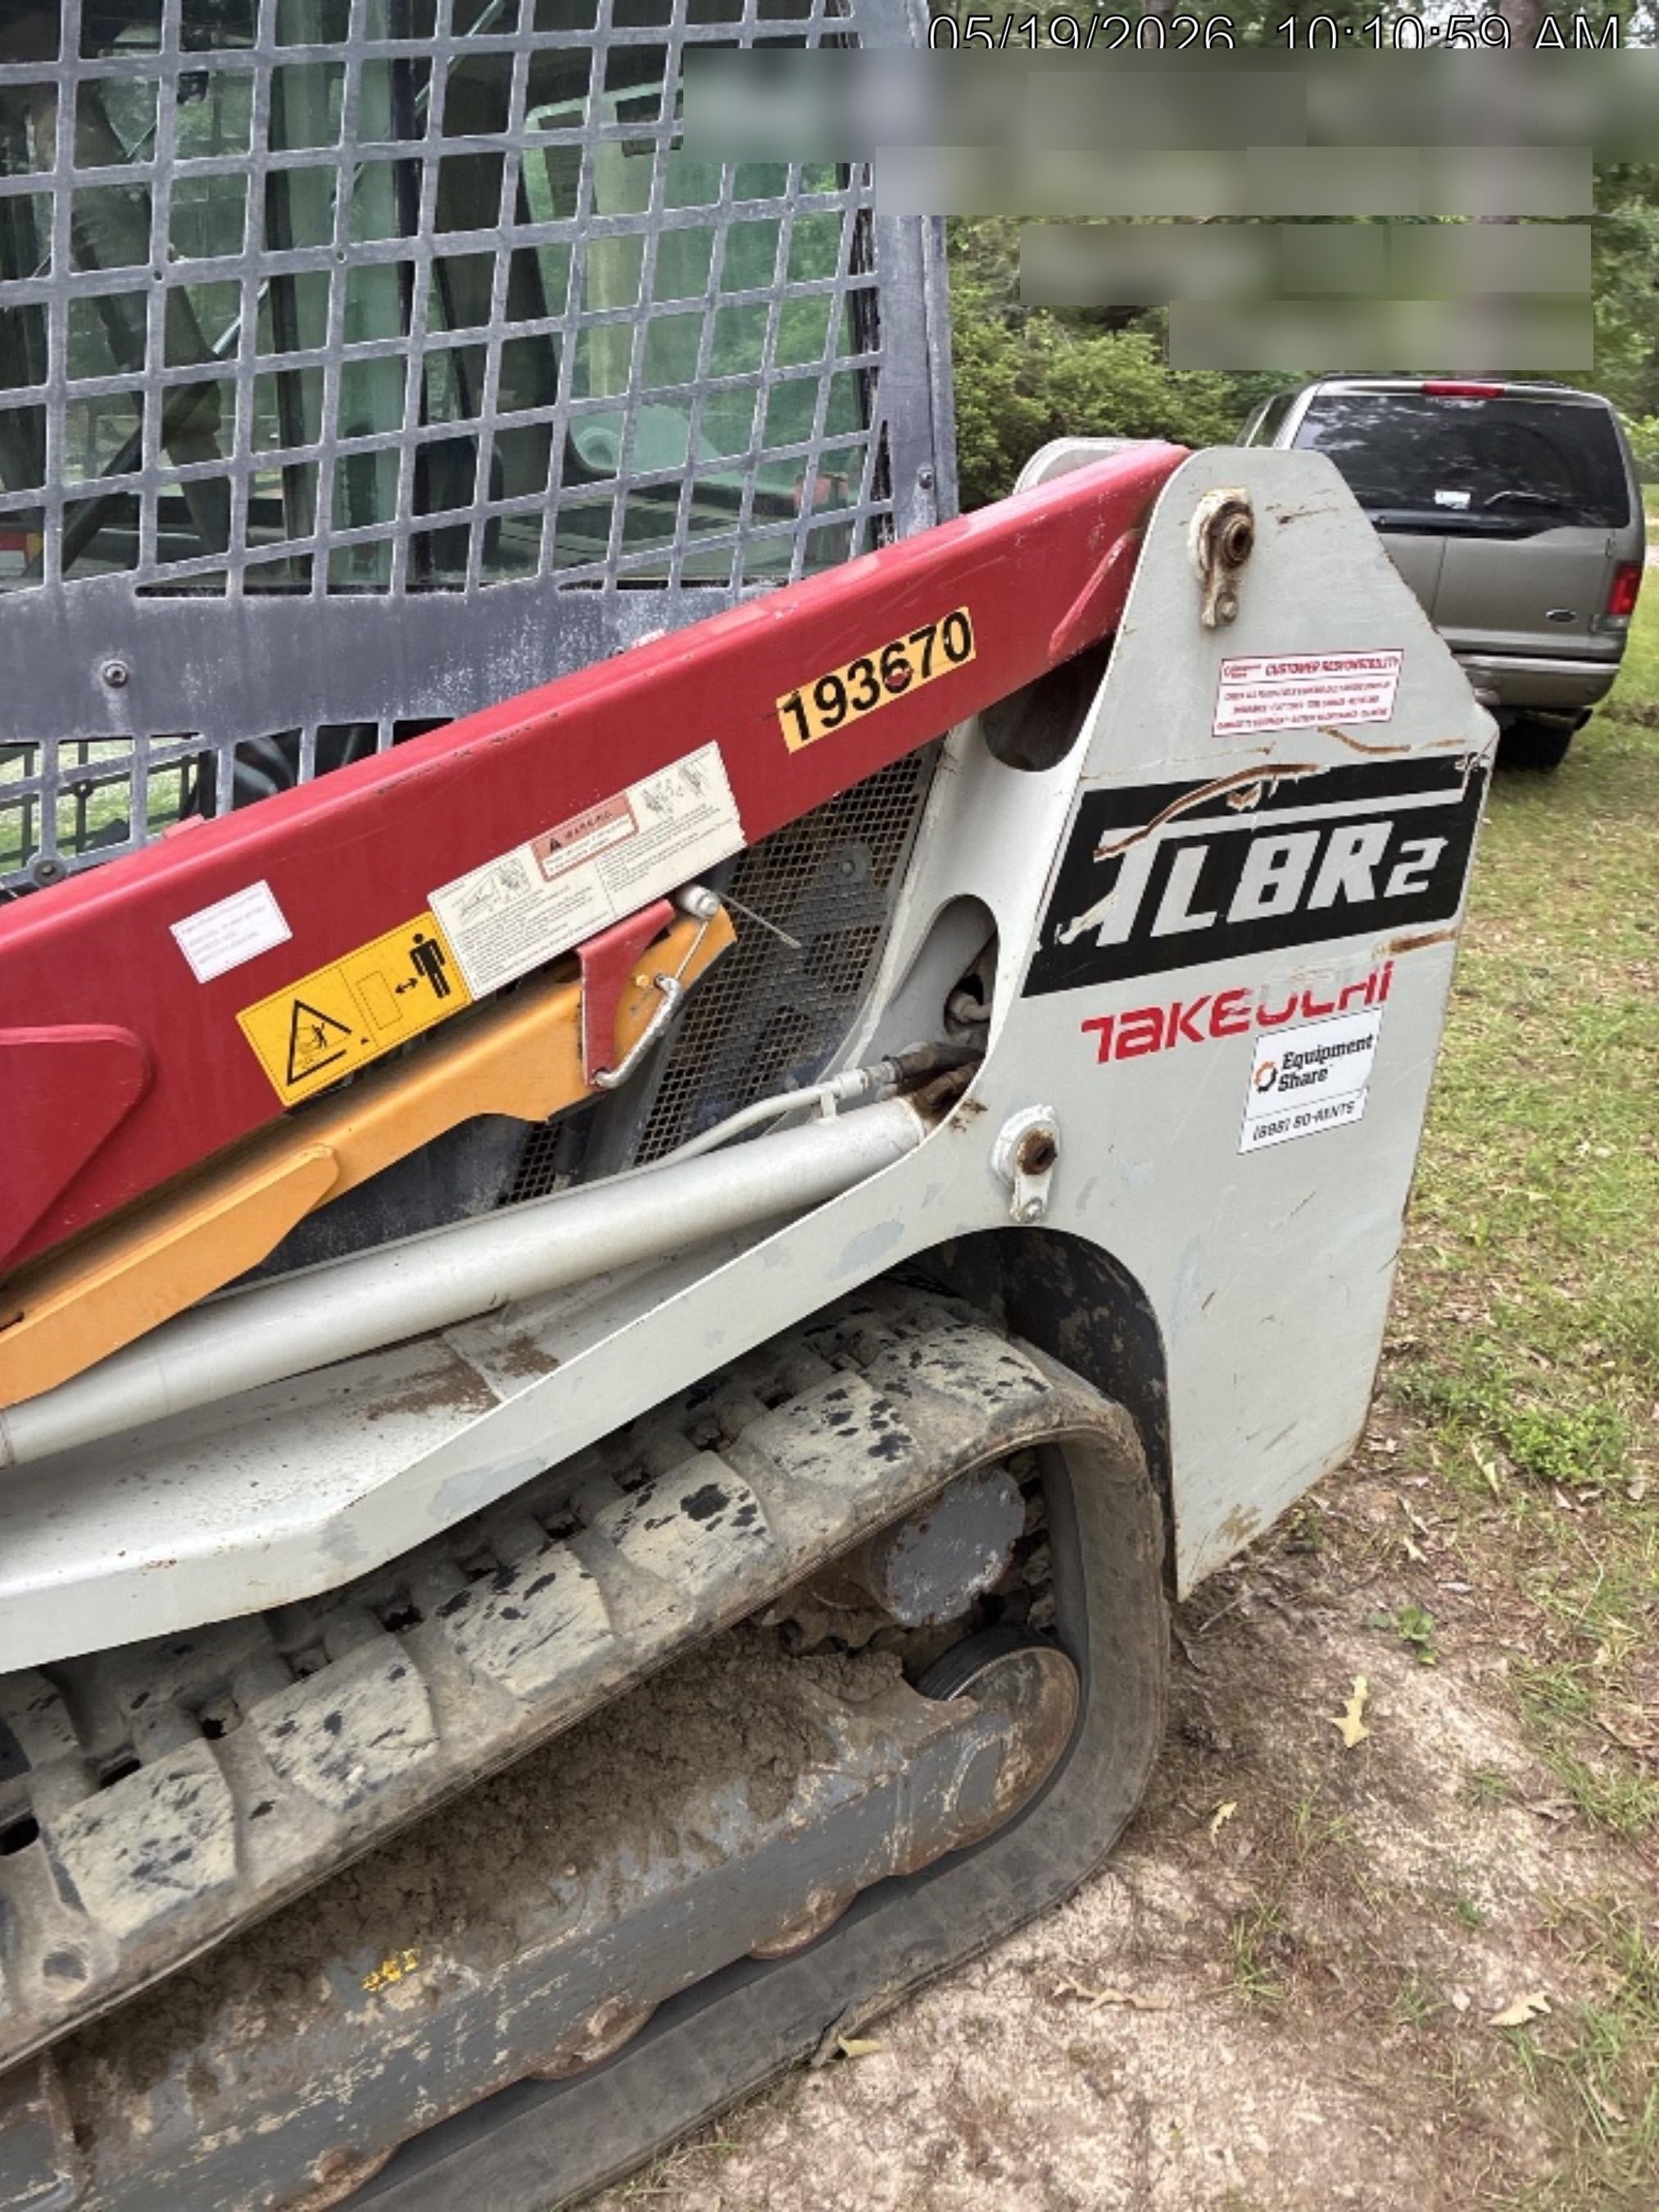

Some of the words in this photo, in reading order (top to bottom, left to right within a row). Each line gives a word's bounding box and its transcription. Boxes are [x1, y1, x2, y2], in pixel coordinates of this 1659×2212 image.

[783, 611, 972, 742] 193670
[1282, 1034, 1374, 1071] Equipment
[1277, 1067, 1329, 1092] Share
